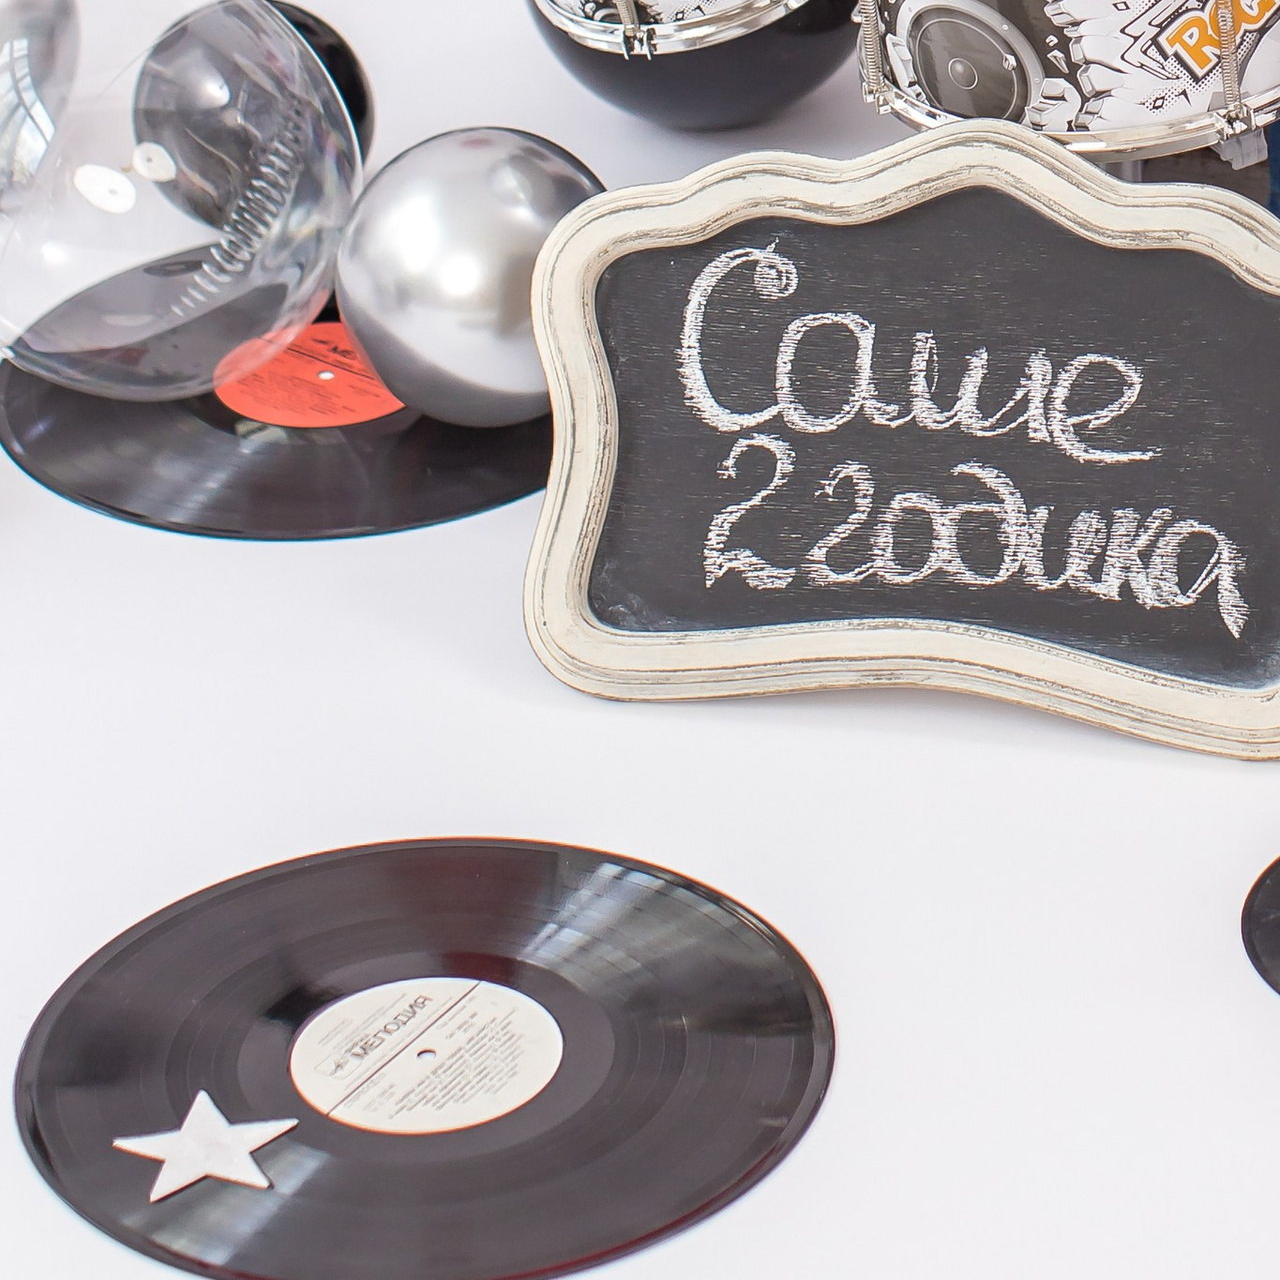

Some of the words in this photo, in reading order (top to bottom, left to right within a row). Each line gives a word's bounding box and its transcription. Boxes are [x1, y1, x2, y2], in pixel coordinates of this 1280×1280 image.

[675, 237, 1160, 465] Саше
[703, 432, 797, 590] 2
[350, 994, 434, 1060] МЕЛОДИЯ
